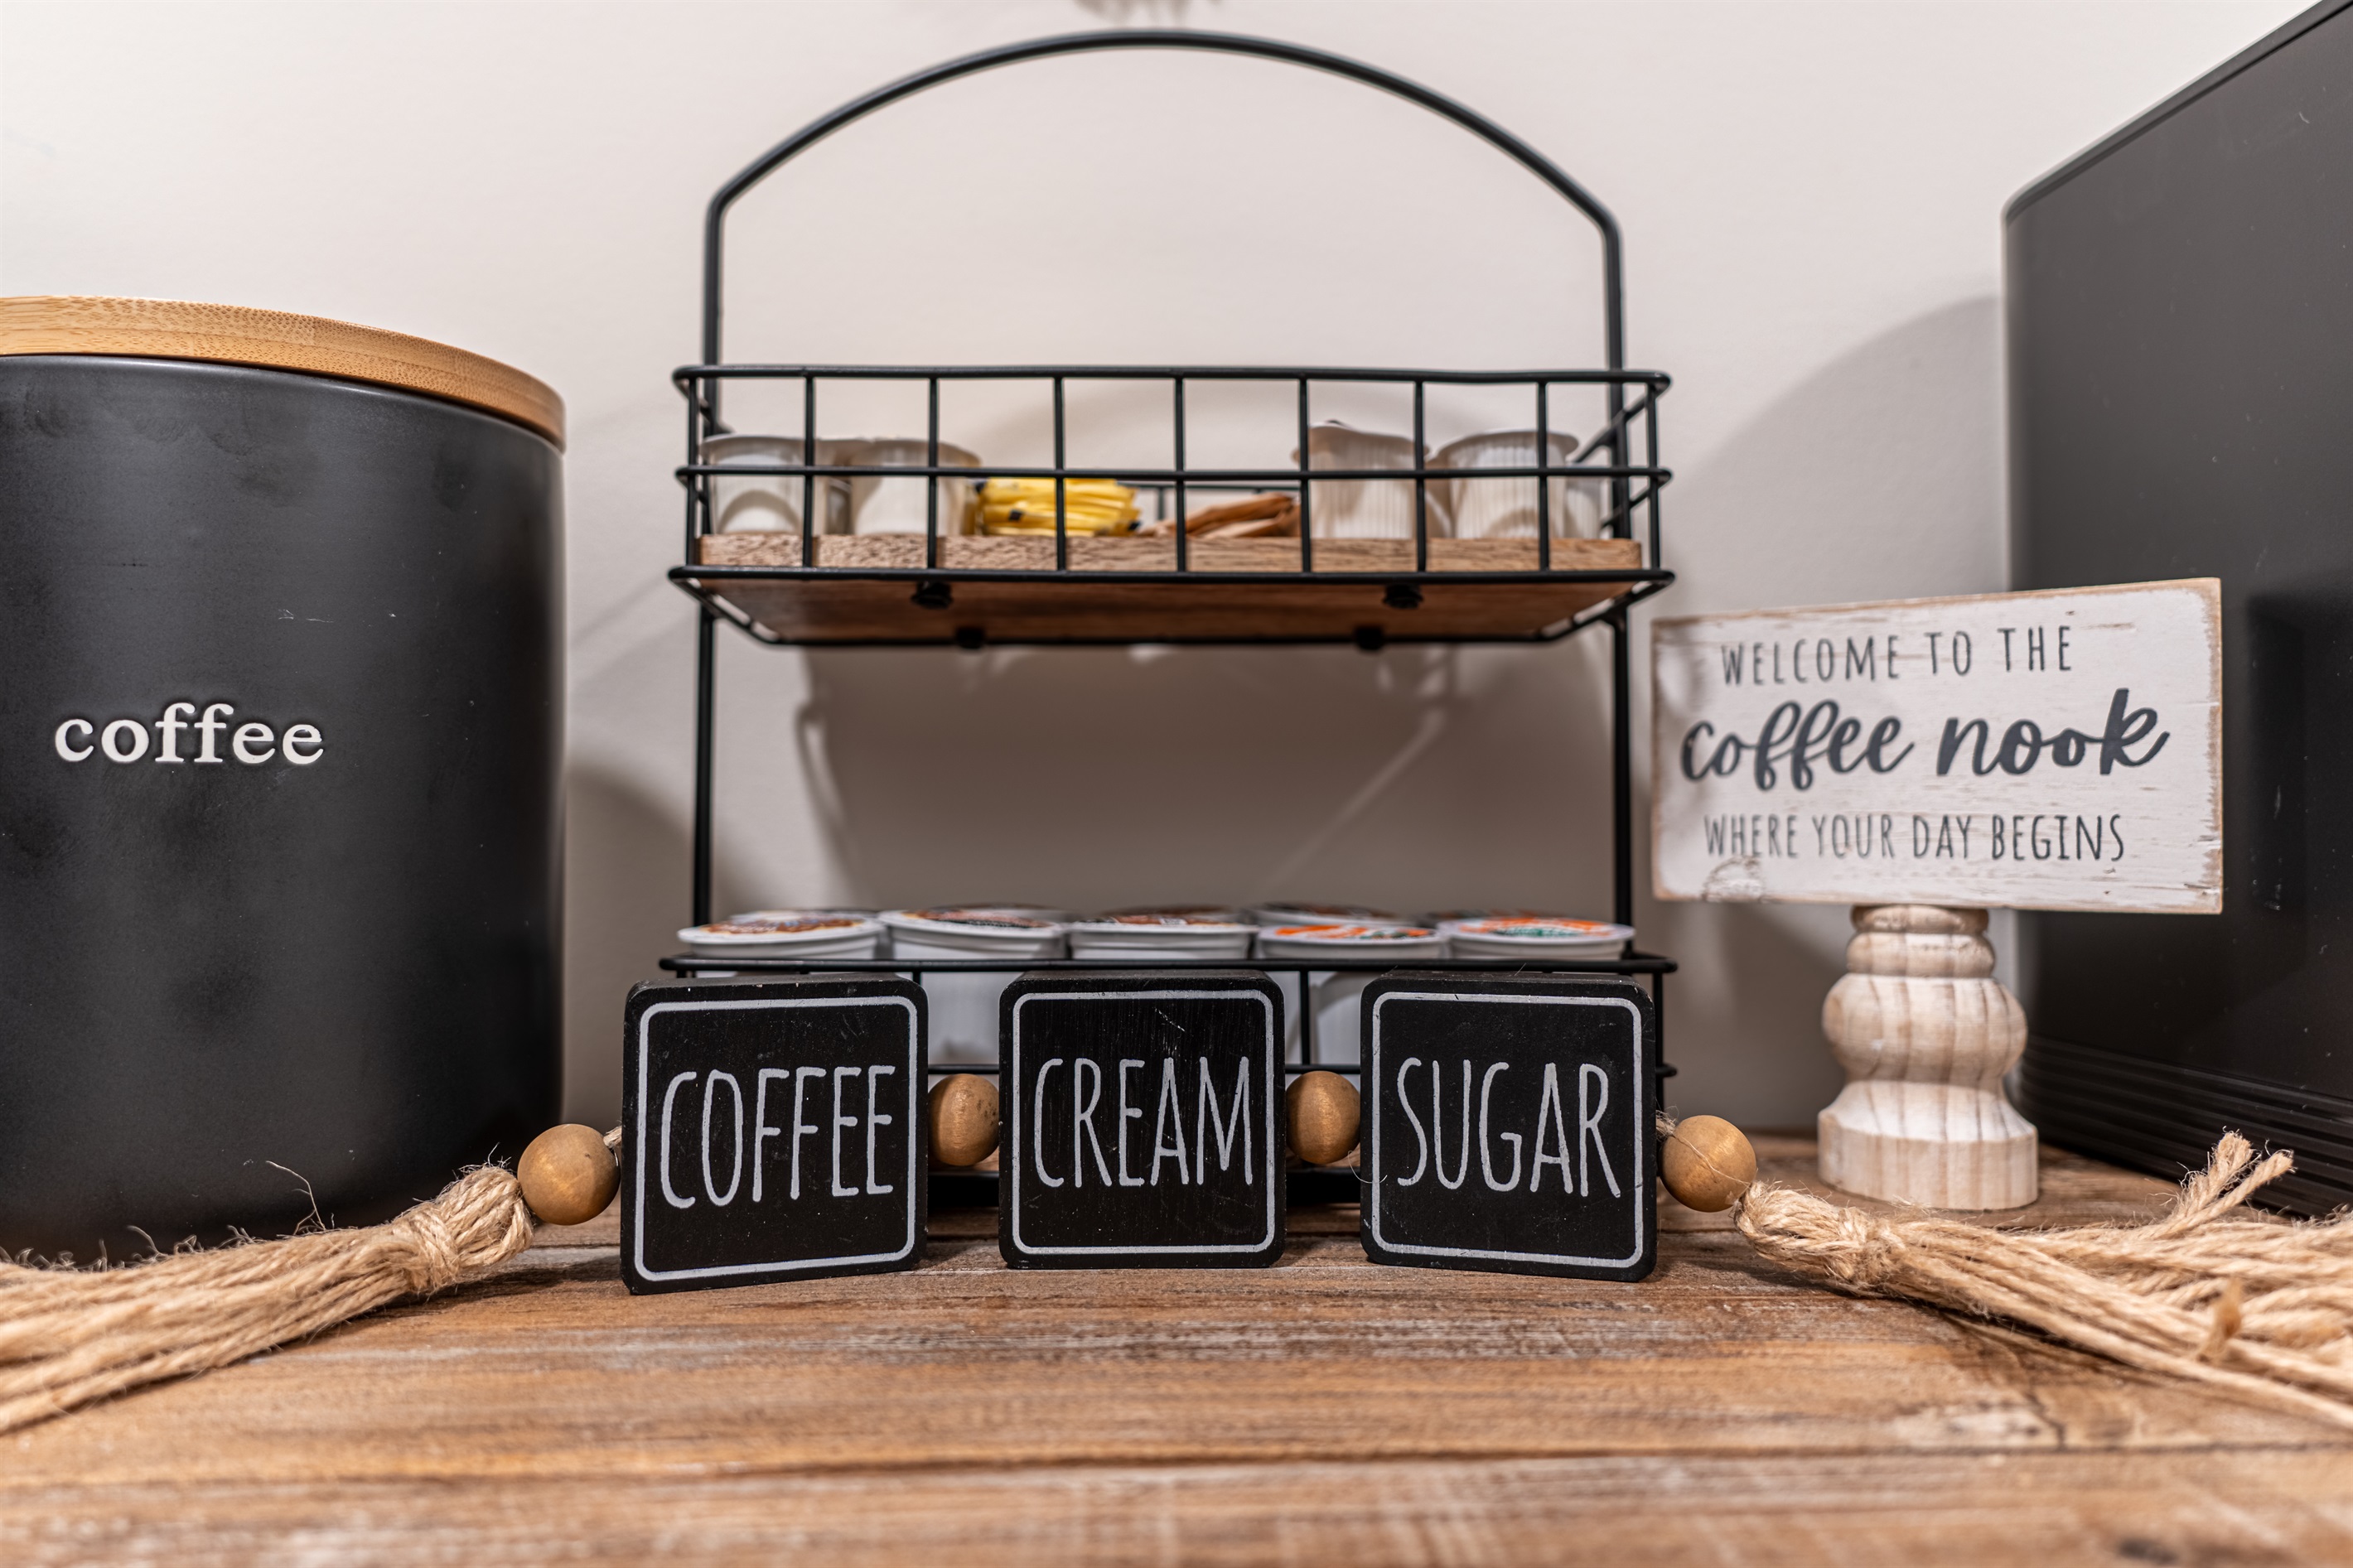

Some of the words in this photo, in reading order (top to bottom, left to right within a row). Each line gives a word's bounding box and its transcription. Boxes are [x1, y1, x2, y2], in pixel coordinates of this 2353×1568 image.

[1722, 634, 1900, 686] WELCOME
[1925, 631, 1972, 676] TO
[1998, 625, 2072, 672] THE
[55, 702, 324, 764] coffee
[1680, 699, 1914, 791] coffee
[1936, 688, 2170, 776] nook
[1703, 814, 1799, 859] WHERE
[1813, 814, 1895, 859] YOUR
[1912, 814, 1972, 859] DAY
[1992, 813, 2124, 861] BEGINS
[661, 1065, 896, 1209] COFFEE
[1034, 1057, 1253, 1187] CREAM
[1398, 1058, 1621, 1197] SUGAR
